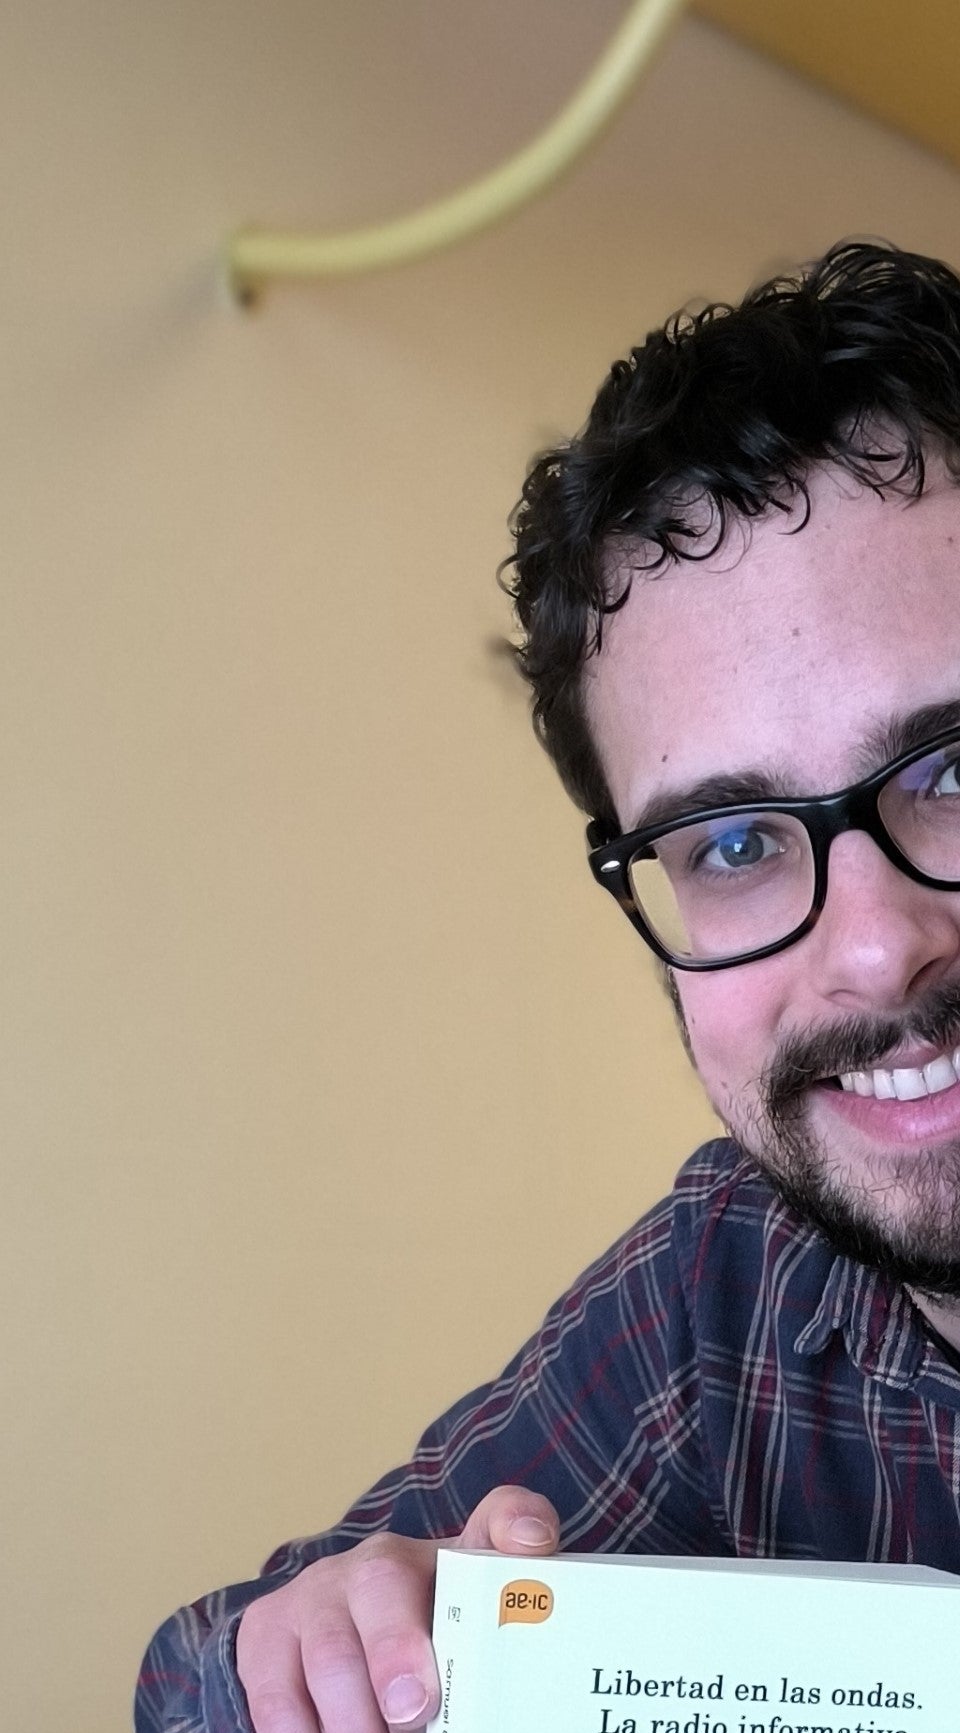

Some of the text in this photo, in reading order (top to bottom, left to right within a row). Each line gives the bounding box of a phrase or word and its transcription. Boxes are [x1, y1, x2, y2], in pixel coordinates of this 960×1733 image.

[591, 1668, 923, 1710] Libertad en las ondas.
